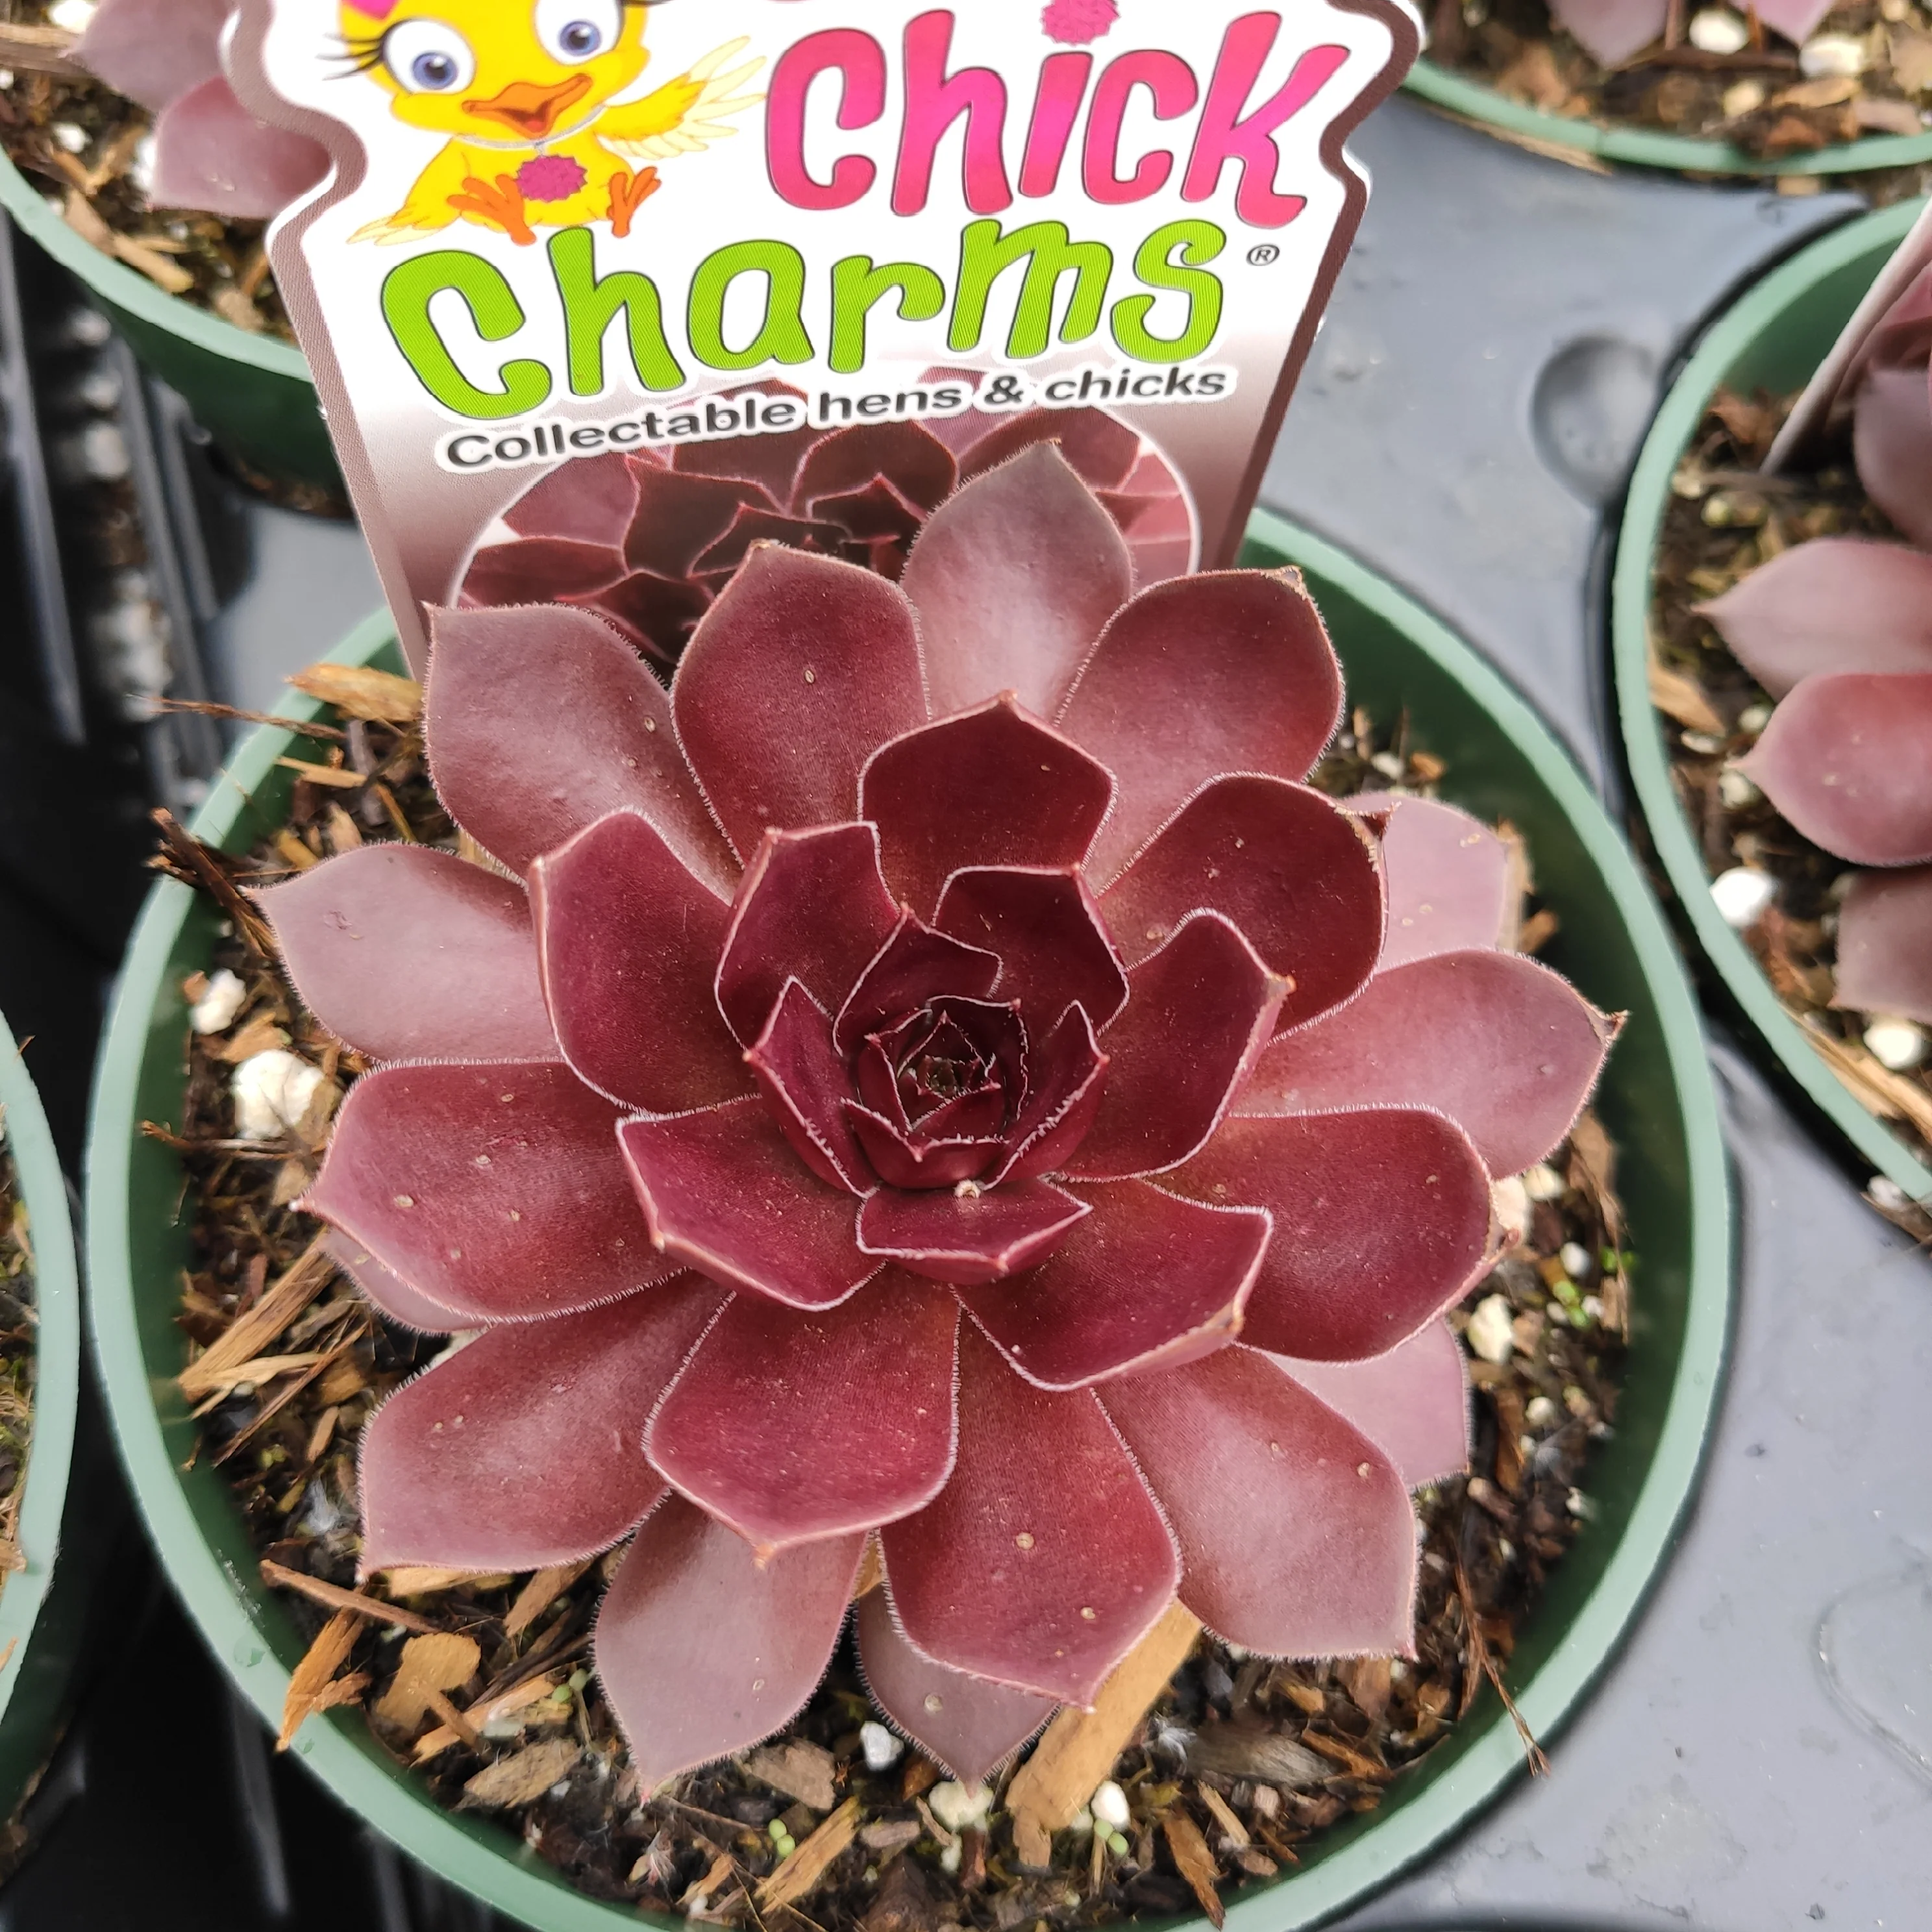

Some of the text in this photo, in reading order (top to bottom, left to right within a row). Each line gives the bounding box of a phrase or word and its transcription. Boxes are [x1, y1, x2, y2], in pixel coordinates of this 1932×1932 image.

[764, 0, 1352, 229] Chick
[381, 218, 1226, 419] Charms
[447, 366, 1227, 467] Collectable hens & chicks
